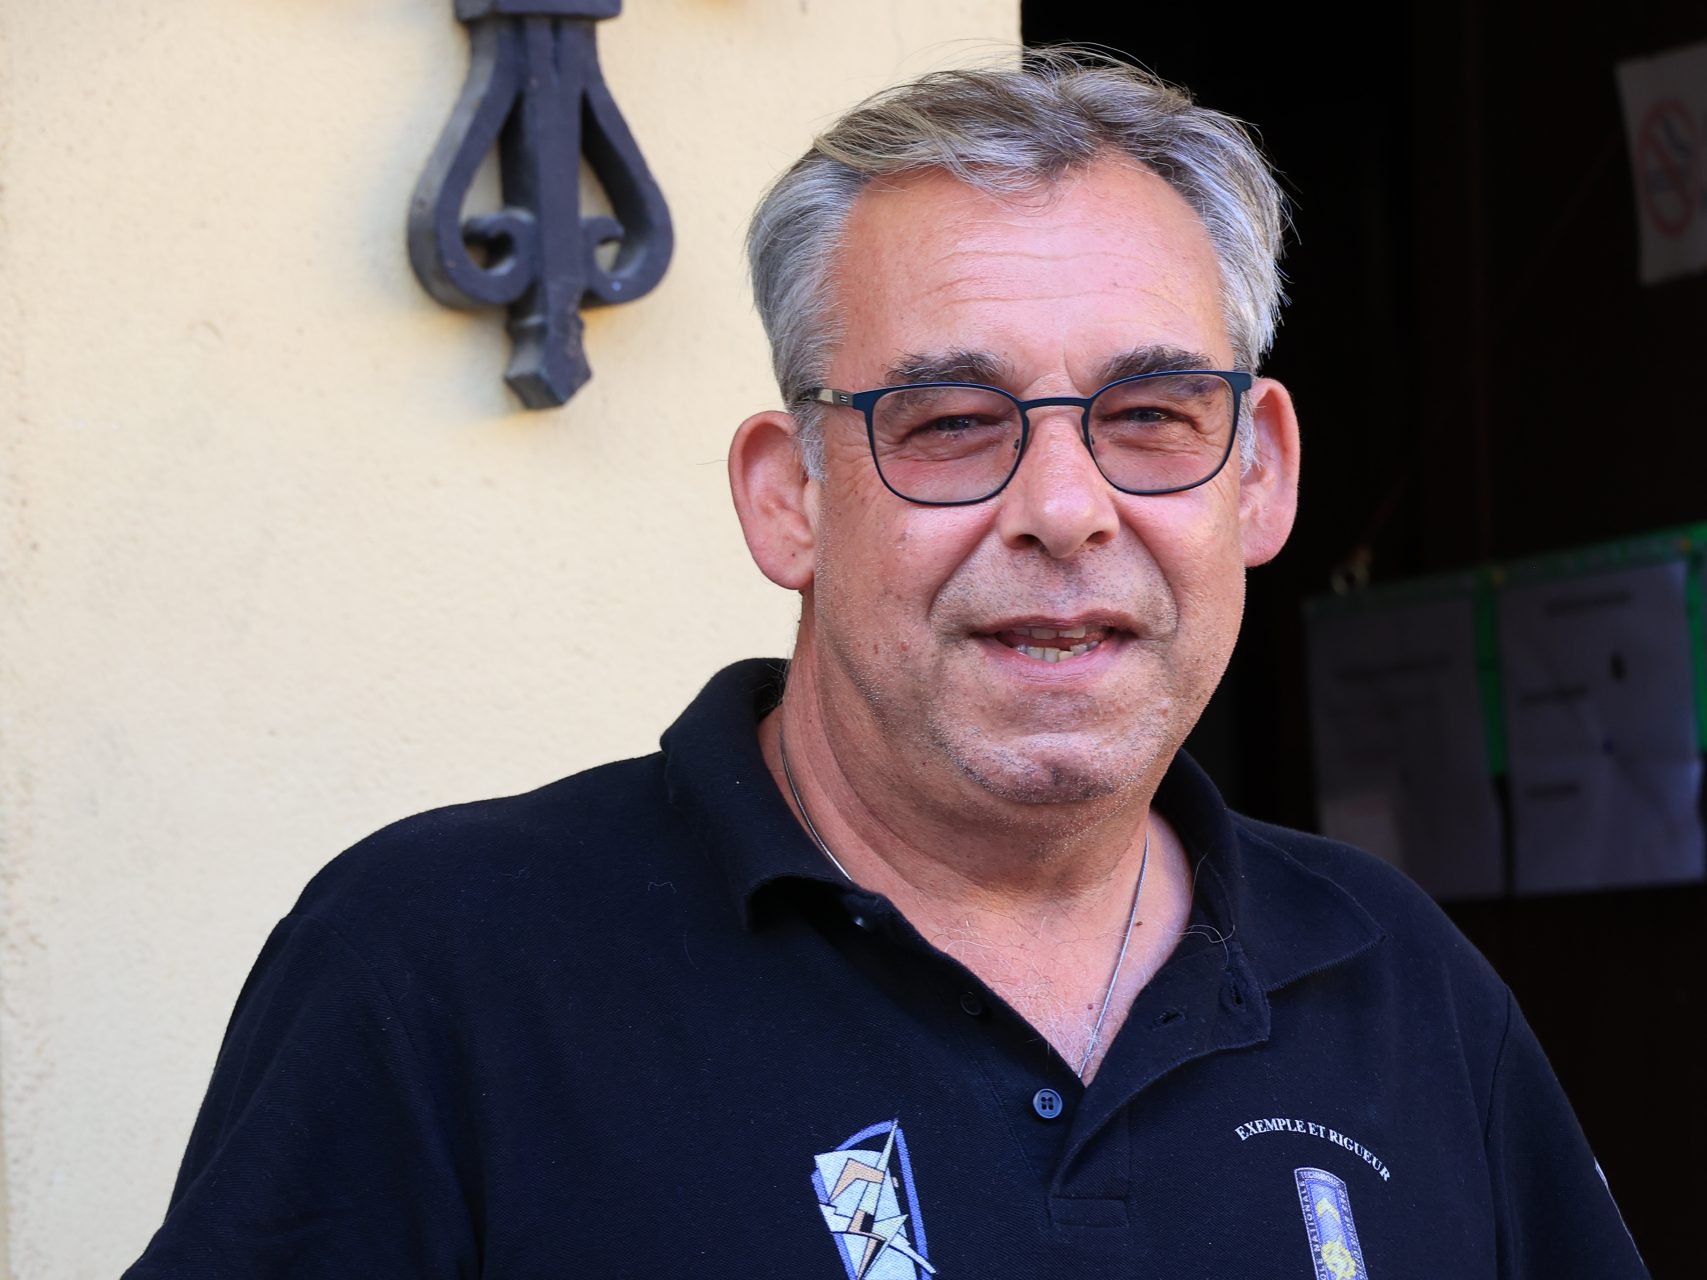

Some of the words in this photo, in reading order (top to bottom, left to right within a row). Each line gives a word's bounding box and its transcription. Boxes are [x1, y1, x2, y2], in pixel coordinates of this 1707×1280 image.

[1234, 1117, 1306, 1141] EXEMPLE
[1307, 1122, 1326, 1139] ET
[1328, 1128, 1391, 1183] RIGUEUR
